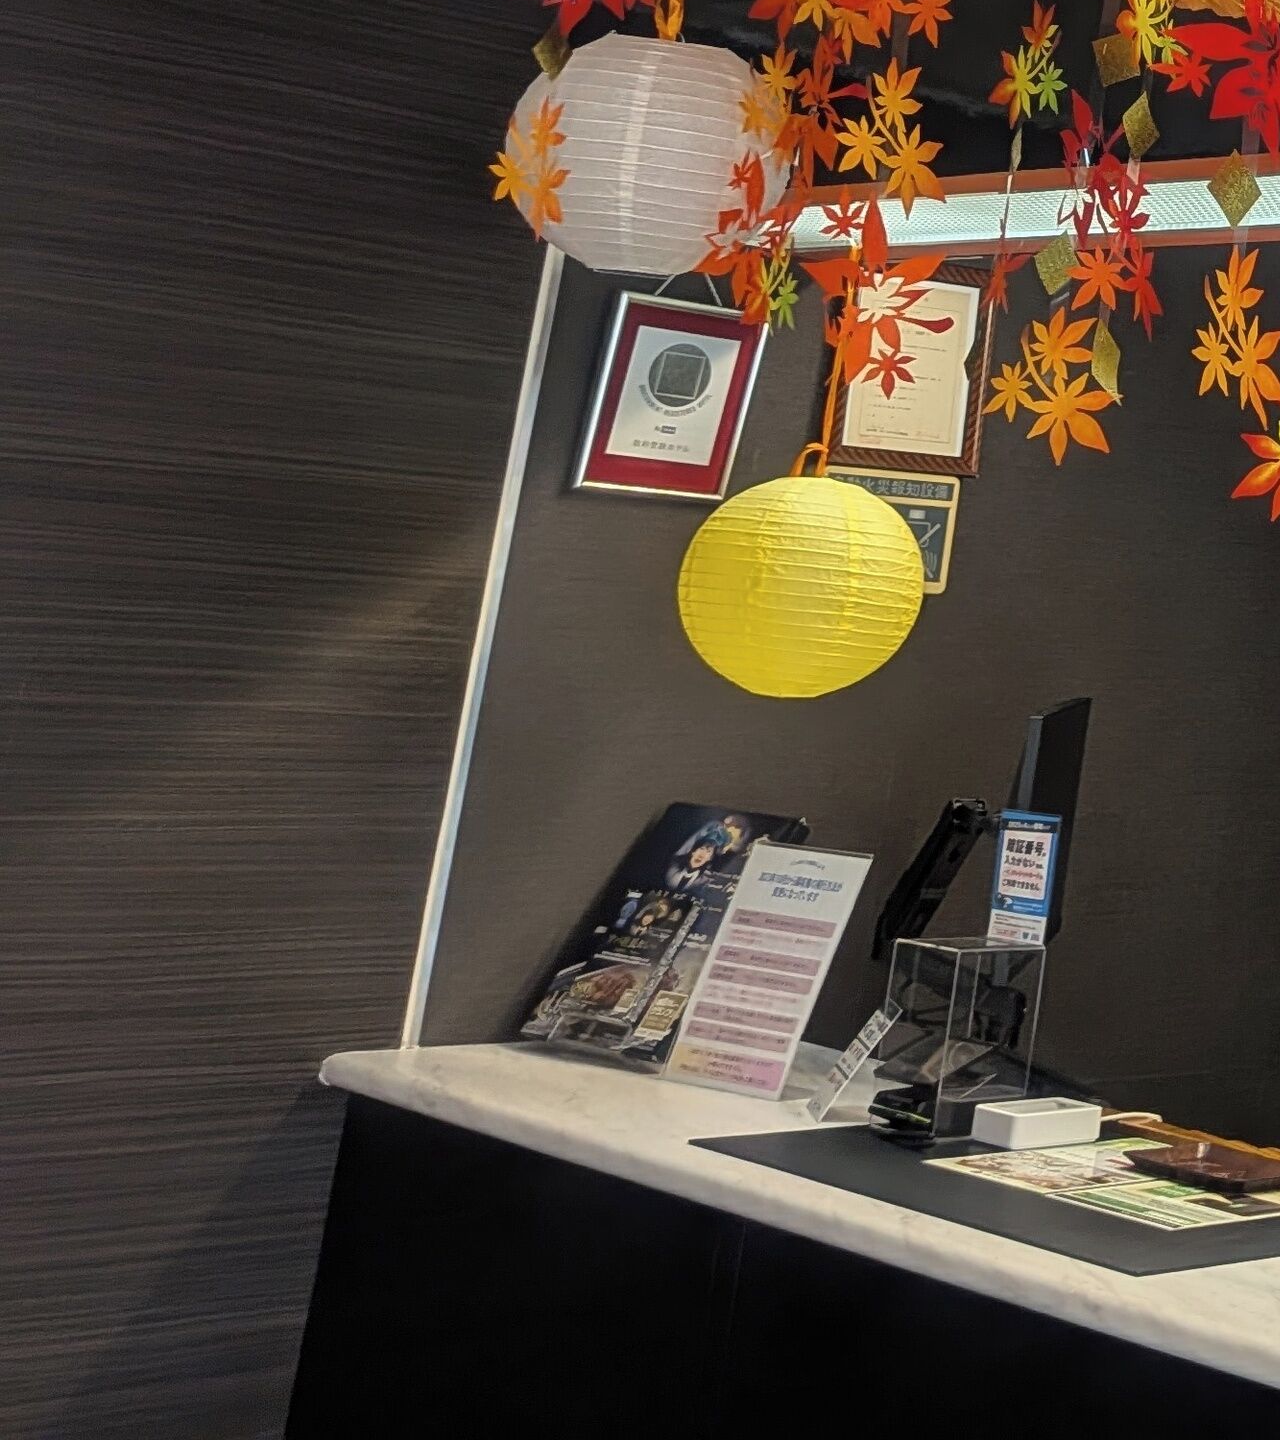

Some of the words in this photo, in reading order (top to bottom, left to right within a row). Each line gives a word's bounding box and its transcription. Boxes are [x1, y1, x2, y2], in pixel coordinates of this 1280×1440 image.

[835, 476, 949, 500] 火災報知設備
